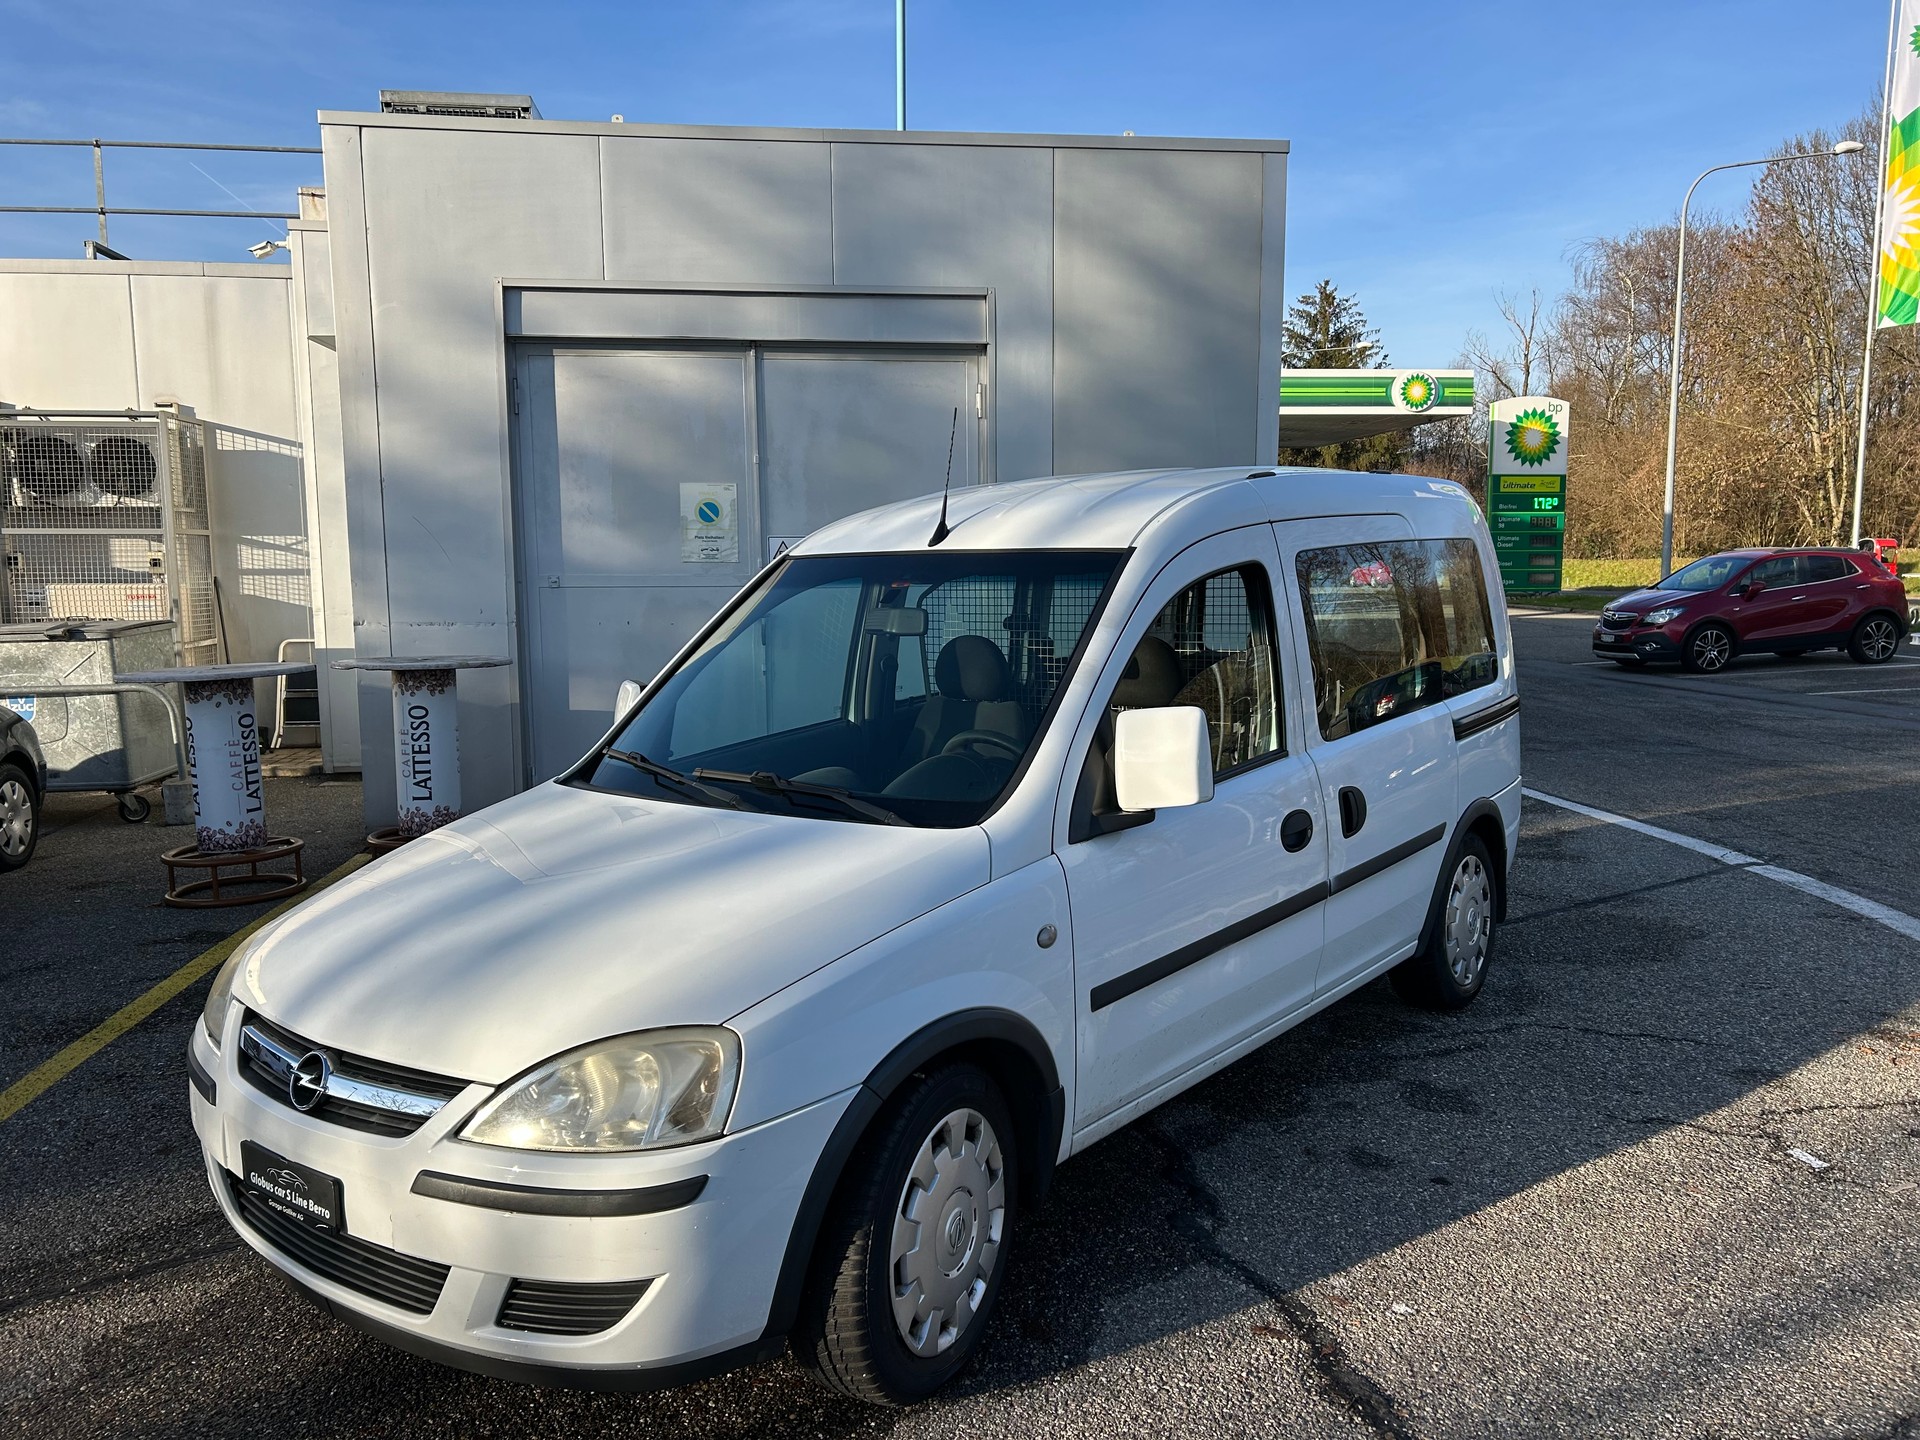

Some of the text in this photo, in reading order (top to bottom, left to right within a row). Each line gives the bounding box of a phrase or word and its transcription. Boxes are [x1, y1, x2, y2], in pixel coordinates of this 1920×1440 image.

[1549, 401, 1563, 414] bp
[10, 703, 34, 712] ZUG
[224, 739, 244, 791] CAFFÈ
[238, 713, 262, 814] LATTESSO
[399, 728, 411, 778] CAFFÈ
[408, 705, 433, 801] LATTESSO
[250, 1171, 330, 1219] Globus car S Line Berro
